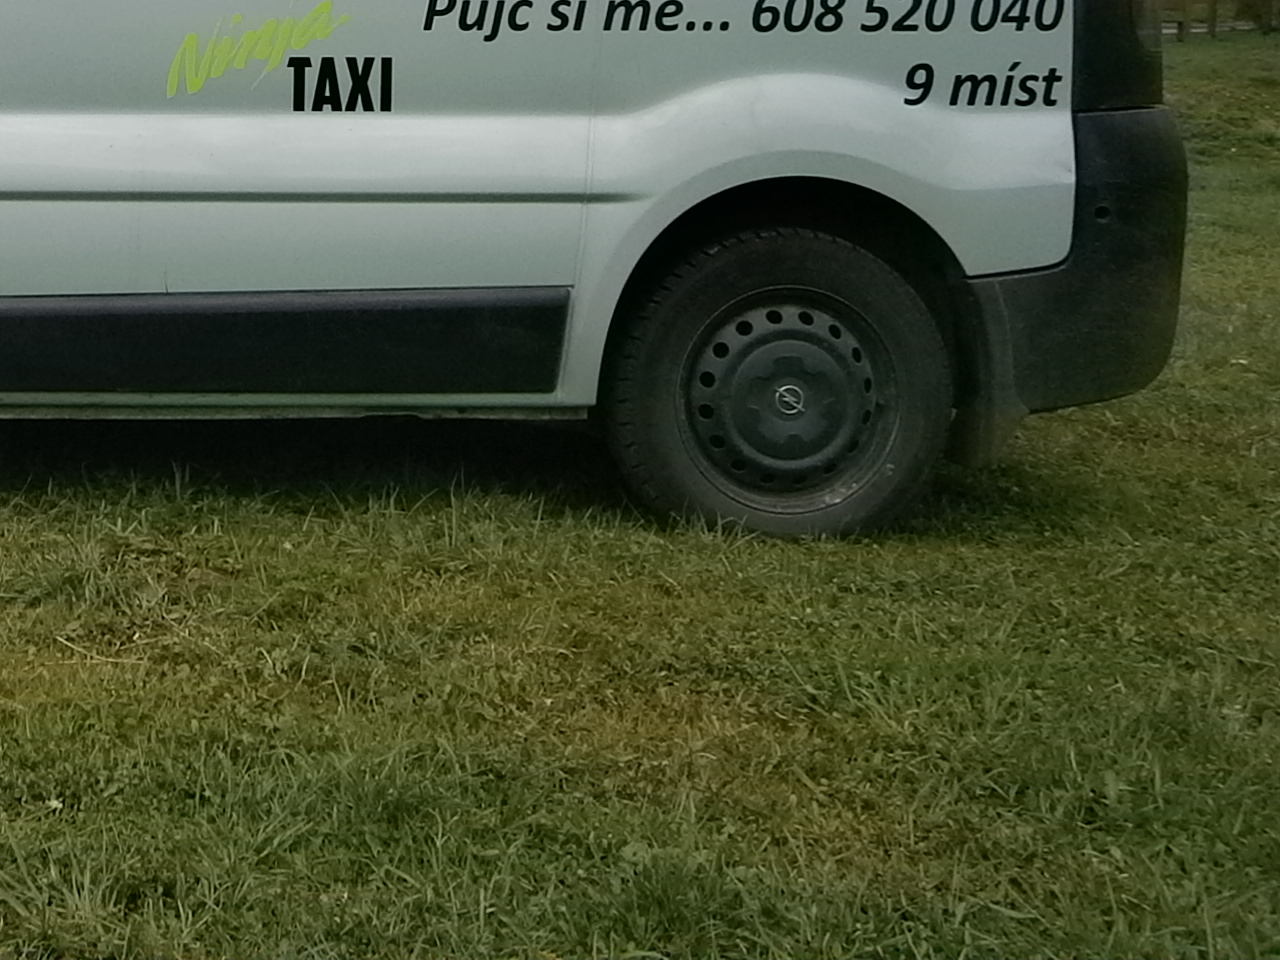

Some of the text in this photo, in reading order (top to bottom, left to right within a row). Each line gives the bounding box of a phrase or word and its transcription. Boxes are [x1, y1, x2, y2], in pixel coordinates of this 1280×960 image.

[286, 56, 393, 113] TAXI
[903, 61, 1064, 107] 9 míst
